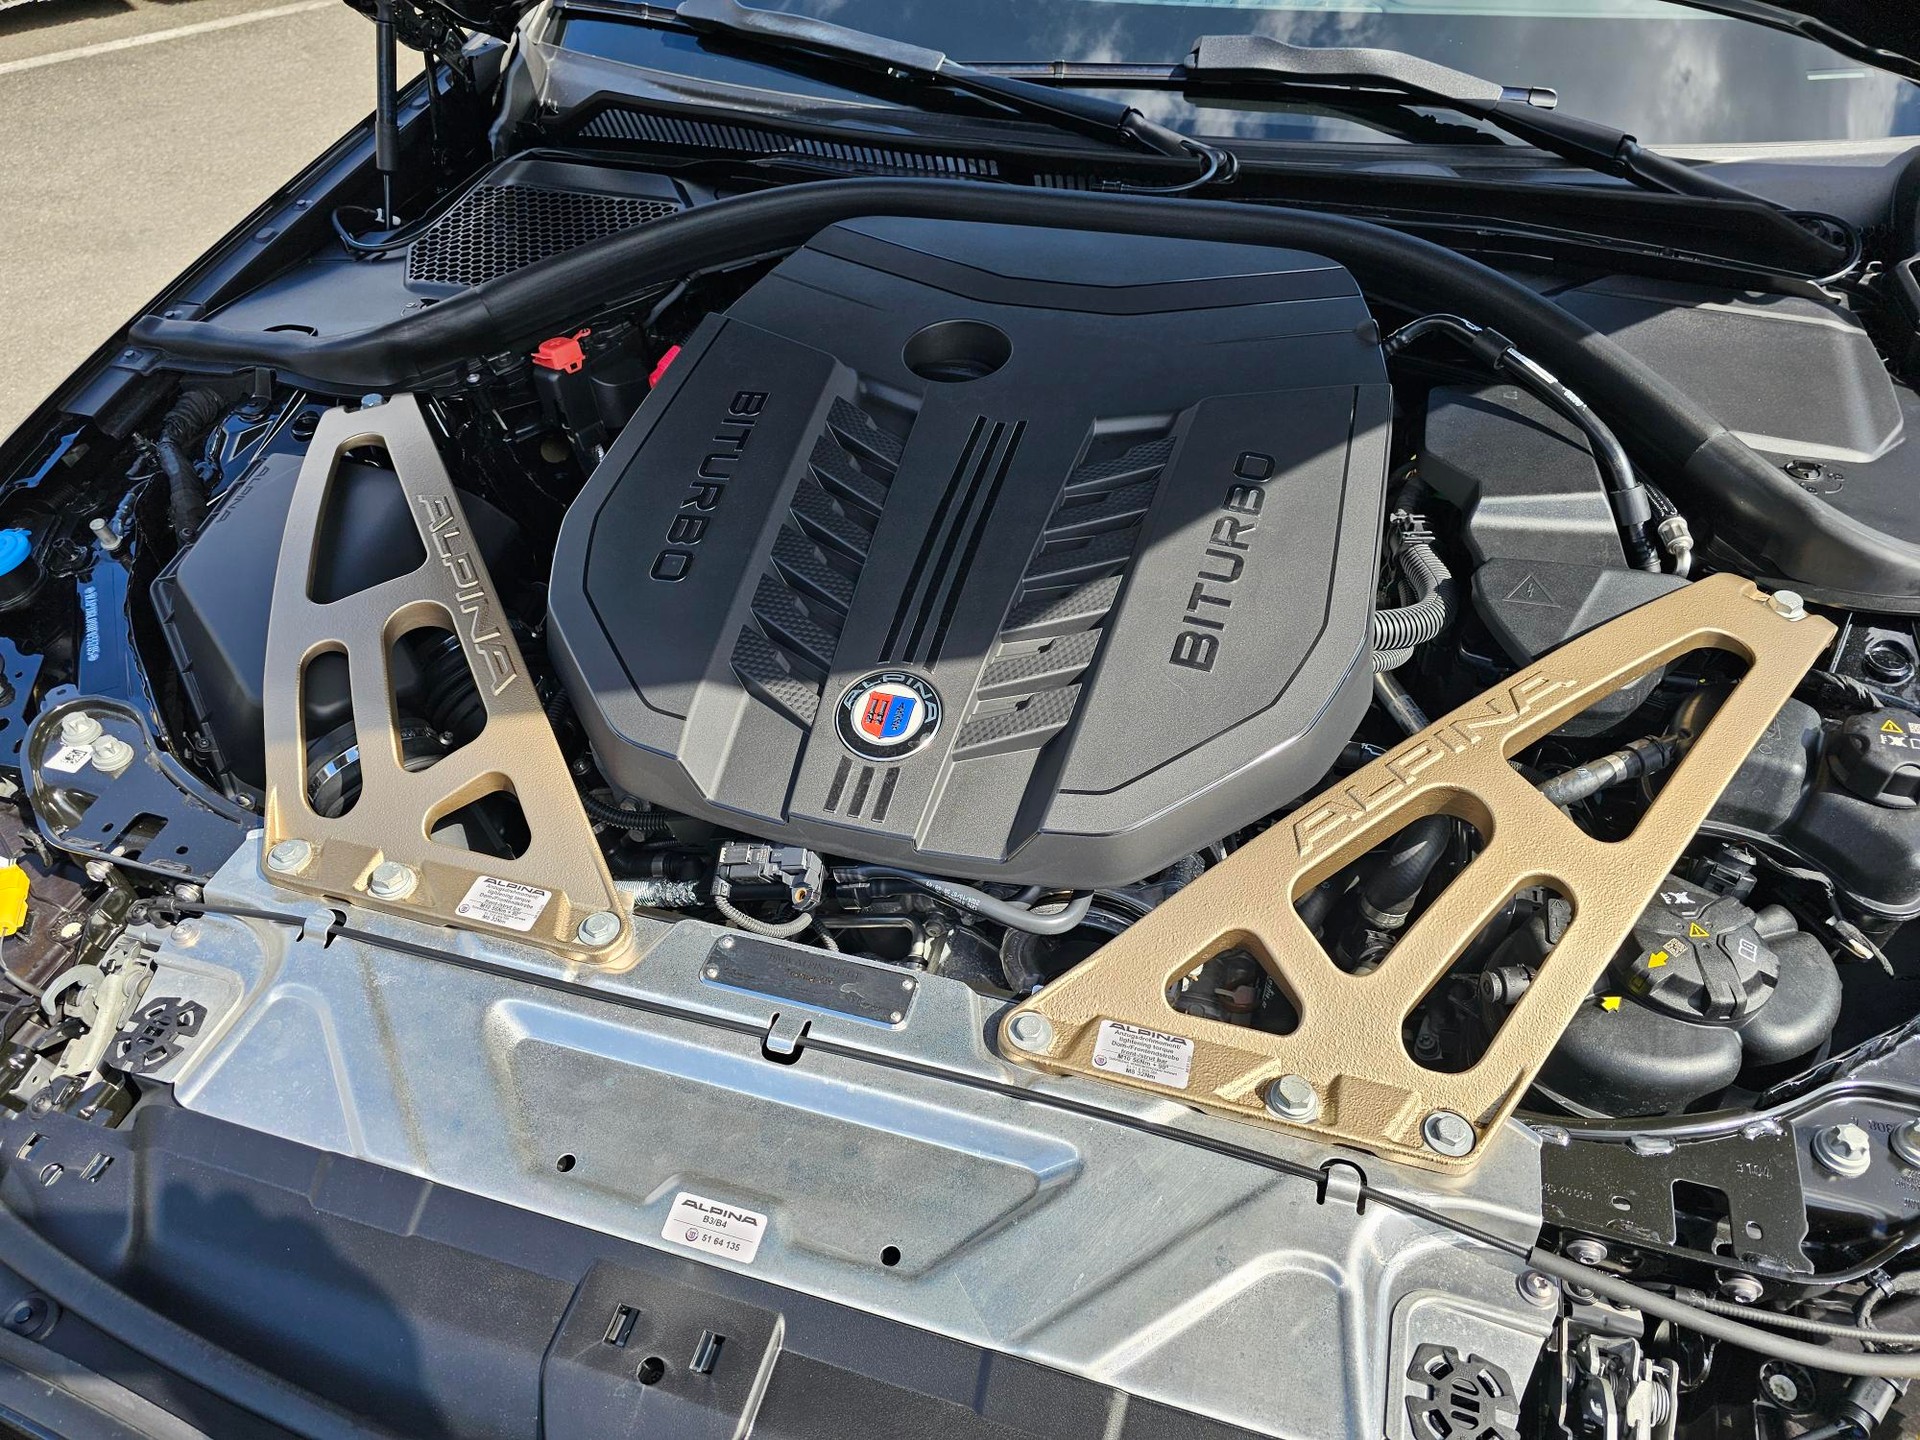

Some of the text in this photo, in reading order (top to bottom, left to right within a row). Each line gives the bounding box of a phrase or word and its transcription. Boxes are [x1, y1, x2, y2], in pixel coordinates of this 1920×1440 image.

[216, 466, 270, 523] ALPINA
[650, 390, 771, 582] BITURBO
[1169, 451, 1276, 673] BITURBO
[417, 494, 518, 697] ALPINA
[843, 673, 939, 724] ALPINA
[1293, 670, 1578, 856] ALPINA
[484, 877, 545, 897] ALPINA
[1109, 1022, 1187, 1046] ALPINA
[681, 1199, 758, 1227] ALPINA
[702, 1215, 728, 1229] B3/B4
[701, 1233, 741, 1252] 51 64 135
